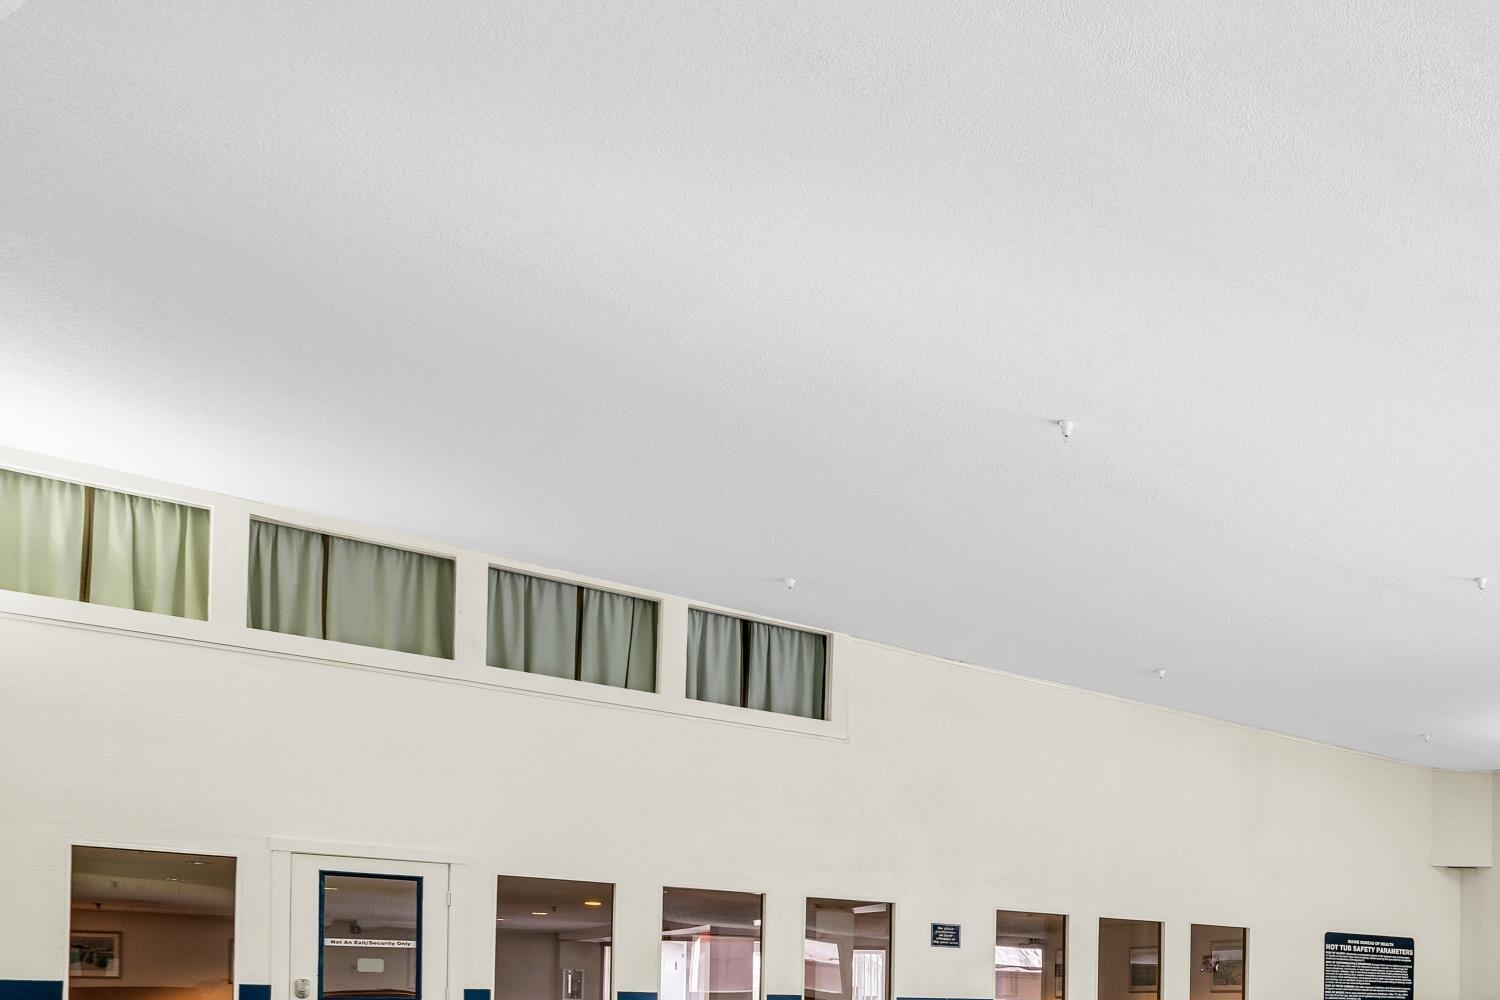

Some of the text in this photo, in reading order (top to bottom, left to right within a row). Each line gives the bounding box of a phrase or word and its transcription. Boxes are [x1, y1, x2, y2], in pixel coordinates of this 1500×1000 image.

[1325, 943, 1414, 956] HOT TUB SAFETY PARAMETERS
